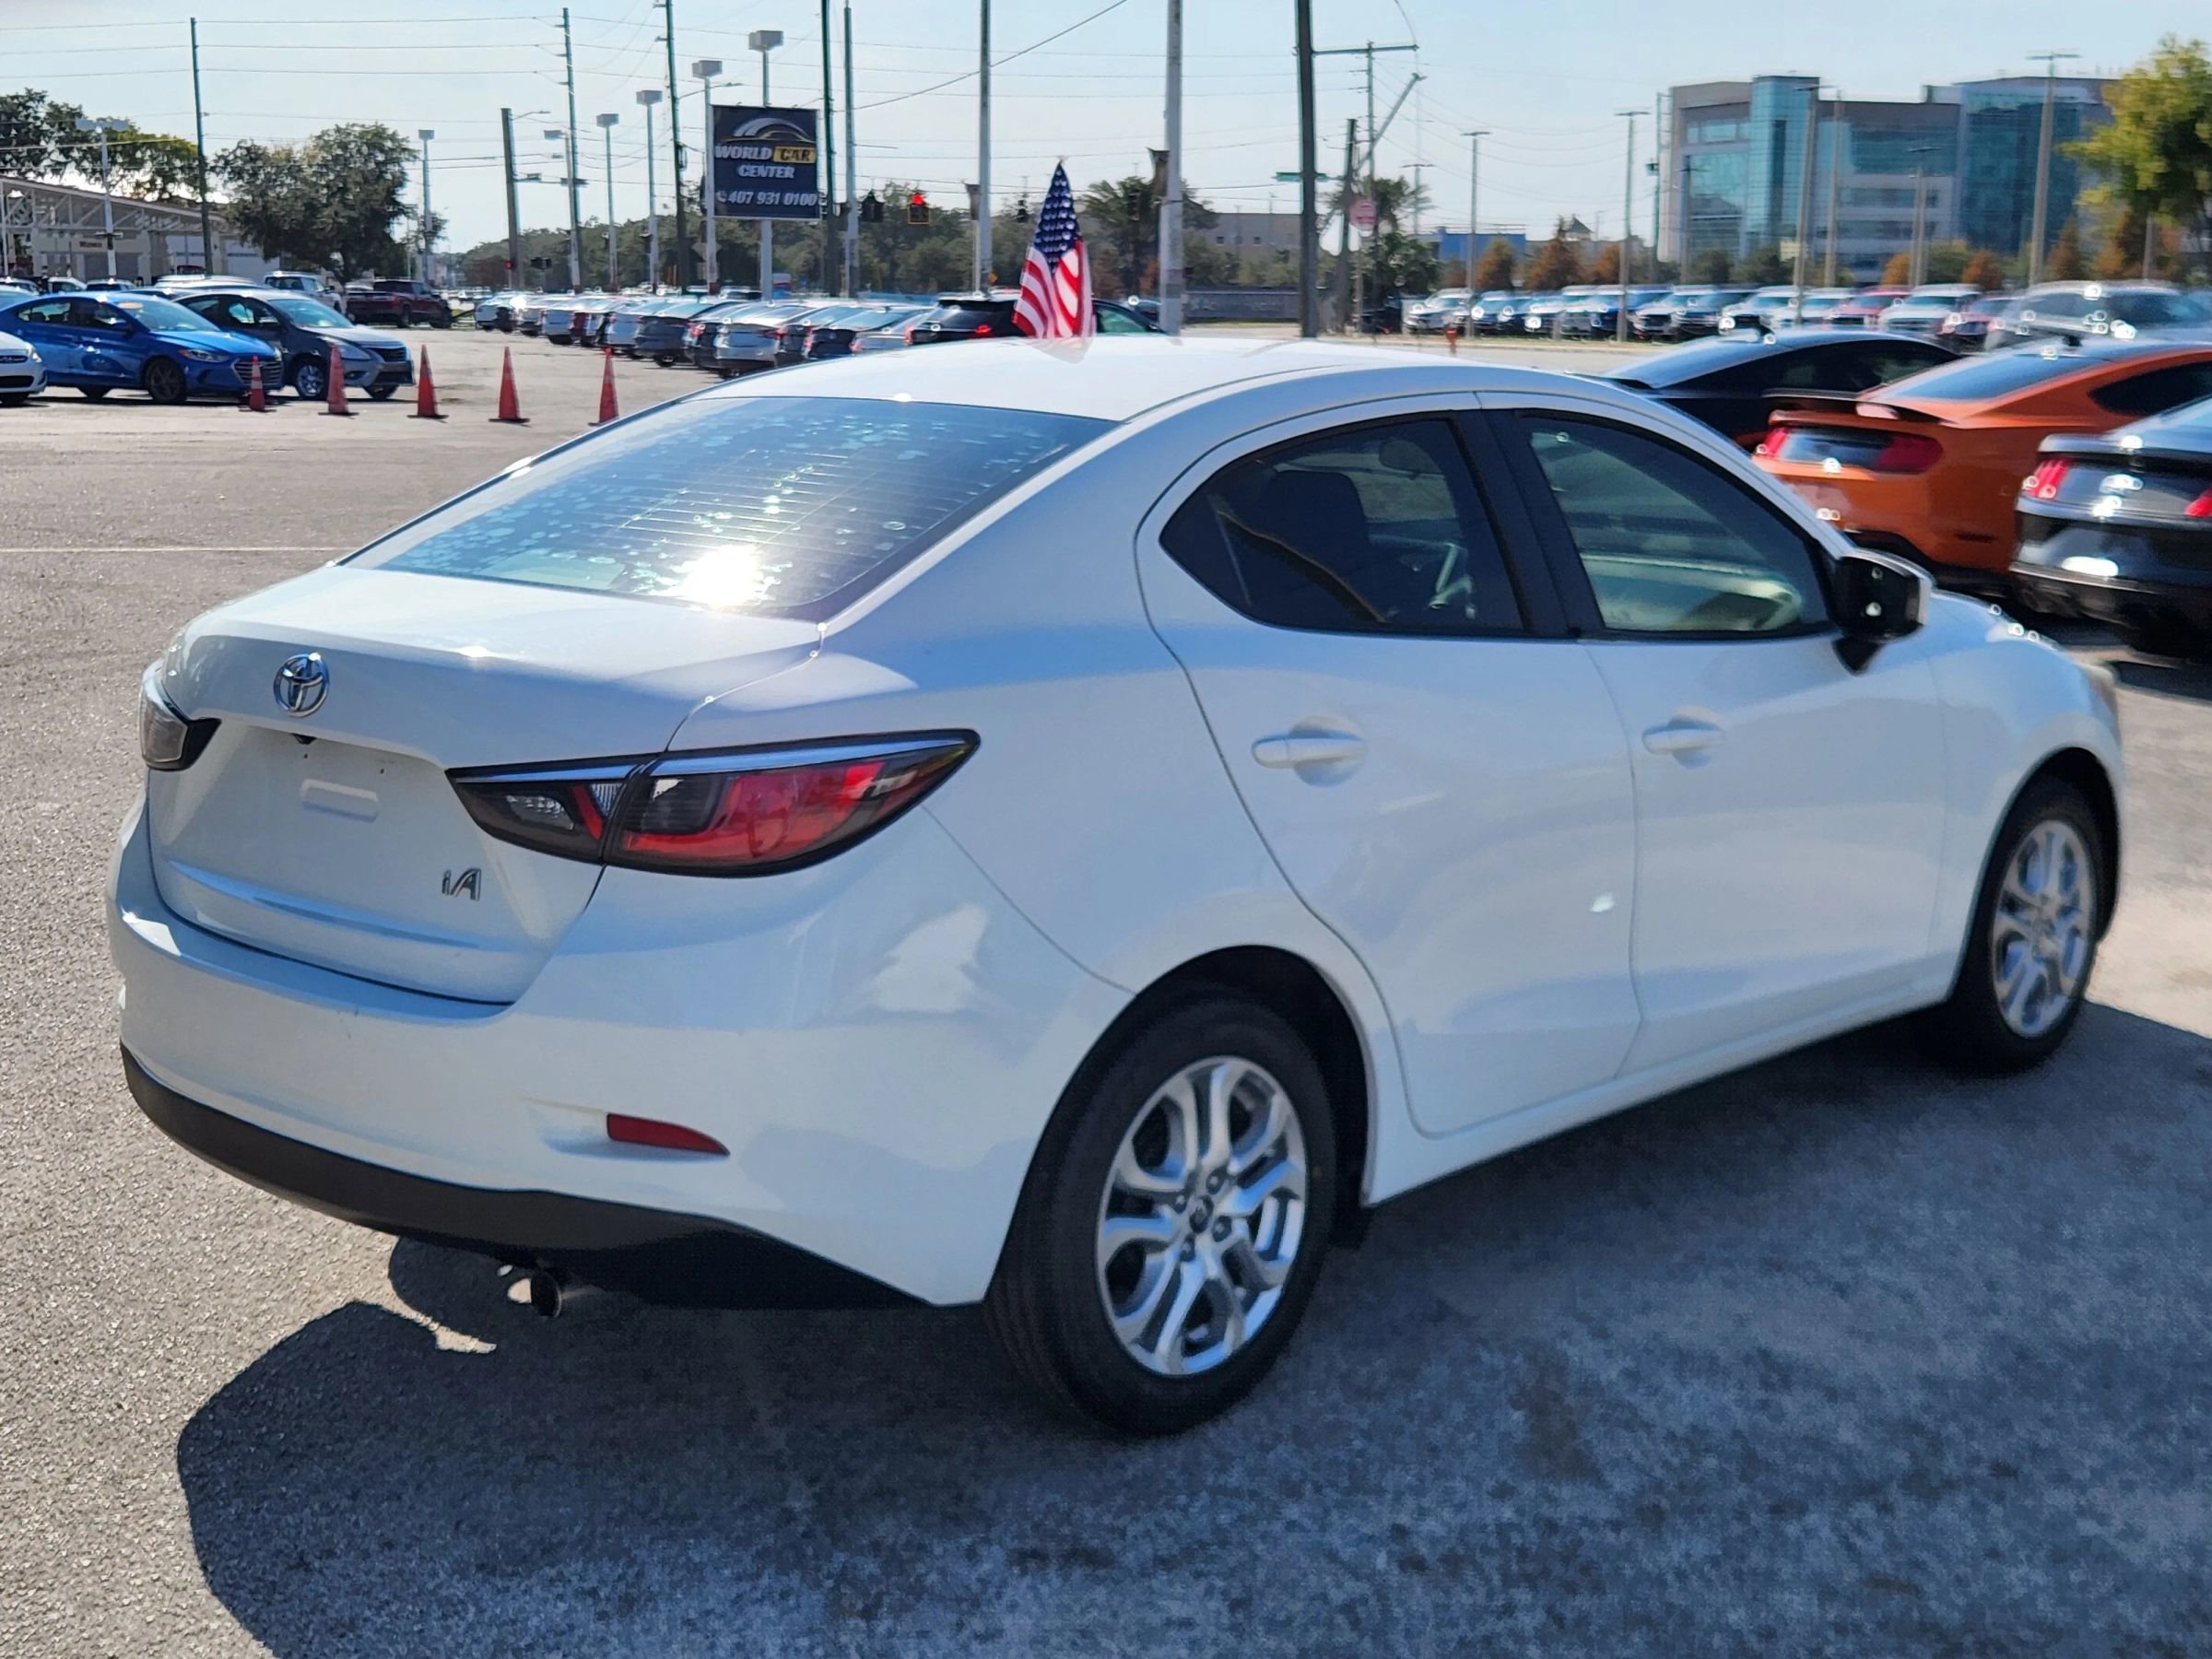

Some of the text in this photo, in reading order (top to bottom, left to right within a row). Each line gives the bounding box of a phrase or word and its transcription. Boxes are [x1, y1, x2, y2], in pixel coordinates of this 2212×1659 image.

[715, 146, 811, 161] WORLD CAR
[738, 165, 795, 179] CENTER
[728, 191, 754, 204] 407
[757, 192, 781, 205] 931
[441, 868, 482, 901] iA
